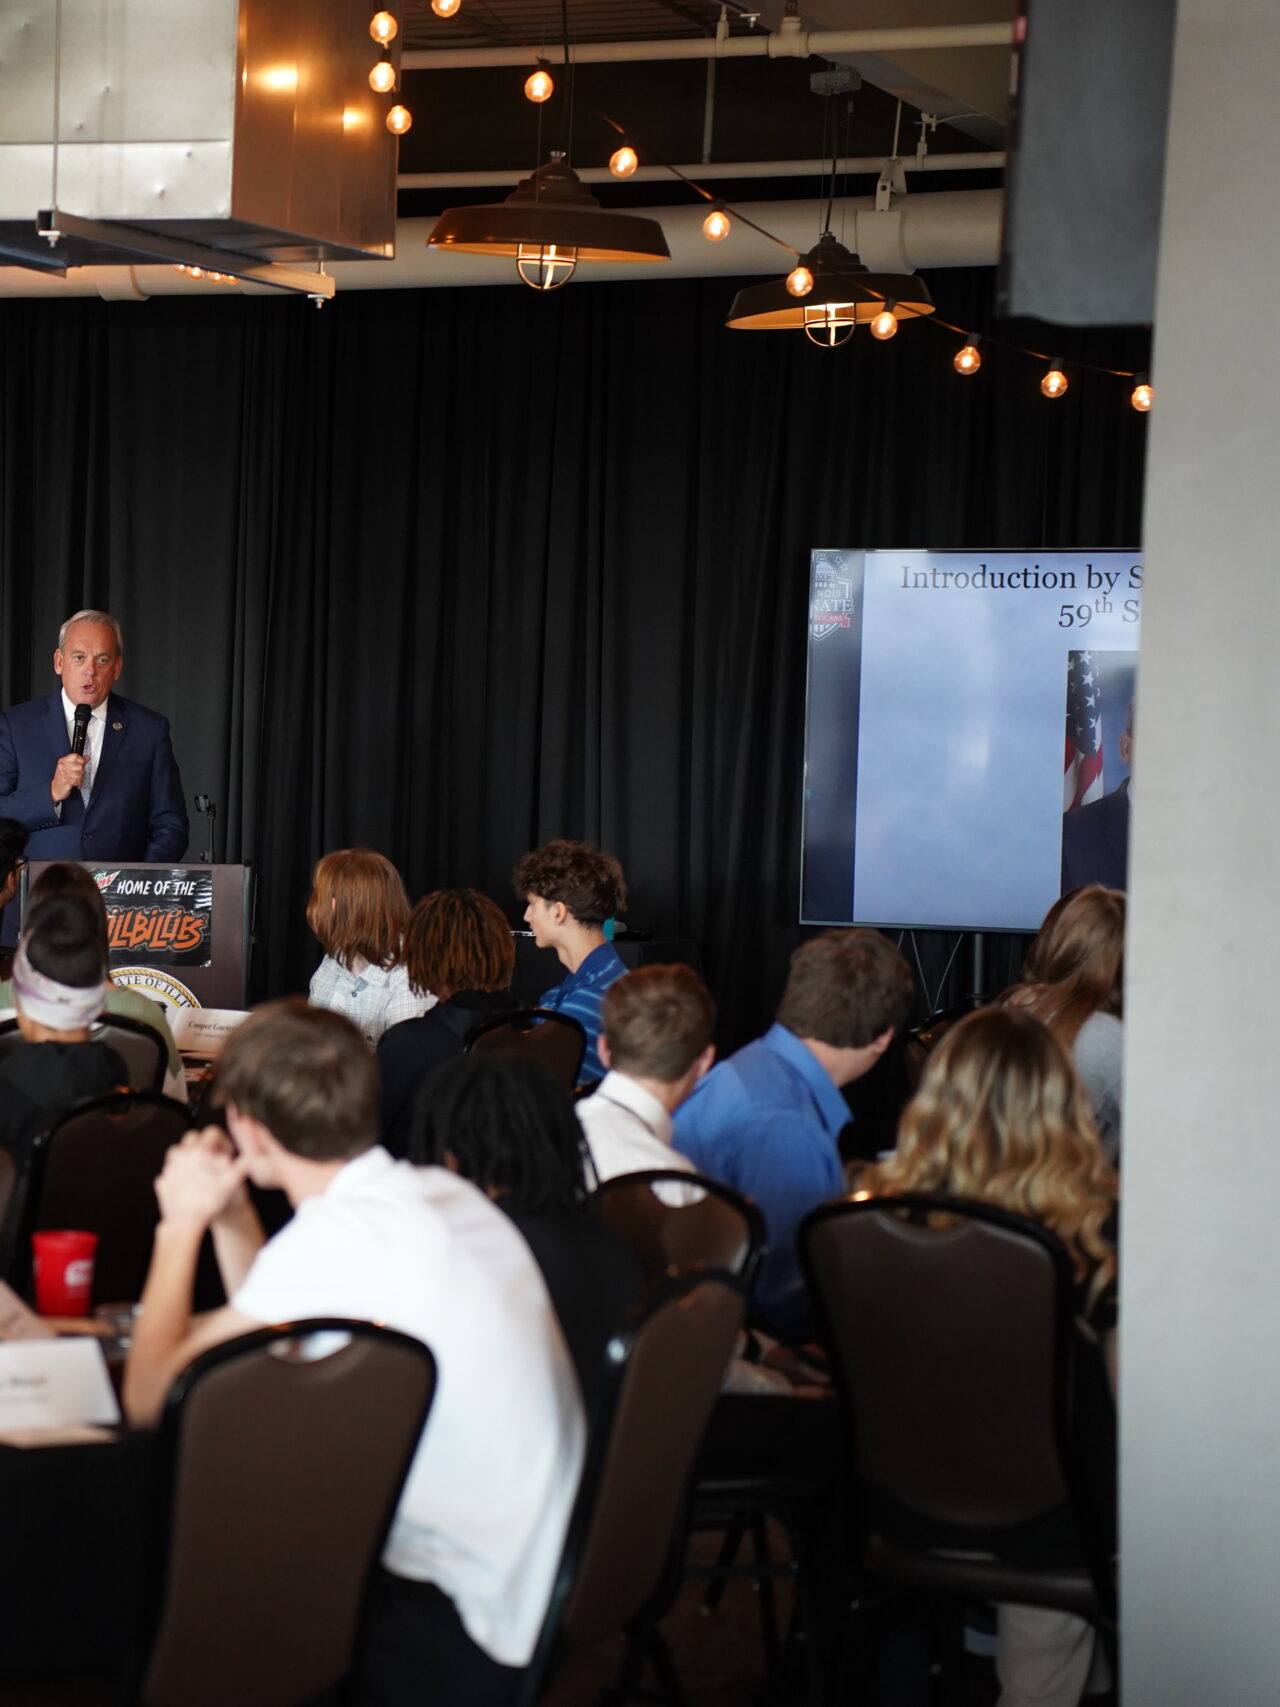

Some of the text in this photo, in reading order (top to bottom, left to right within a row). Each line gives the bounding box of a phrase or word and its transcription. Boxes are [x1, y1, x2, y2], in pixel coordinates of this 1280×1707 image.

[899, 563, 1144, 595] Introduction by S
[1058, 596, 1140, 628] 59th S
[116, 880, 197, 896] HOME OF THE
[106, 907, 208, 949] ILLBILLIES
[116, 975, 191, 1008] ATE OF ILLI
